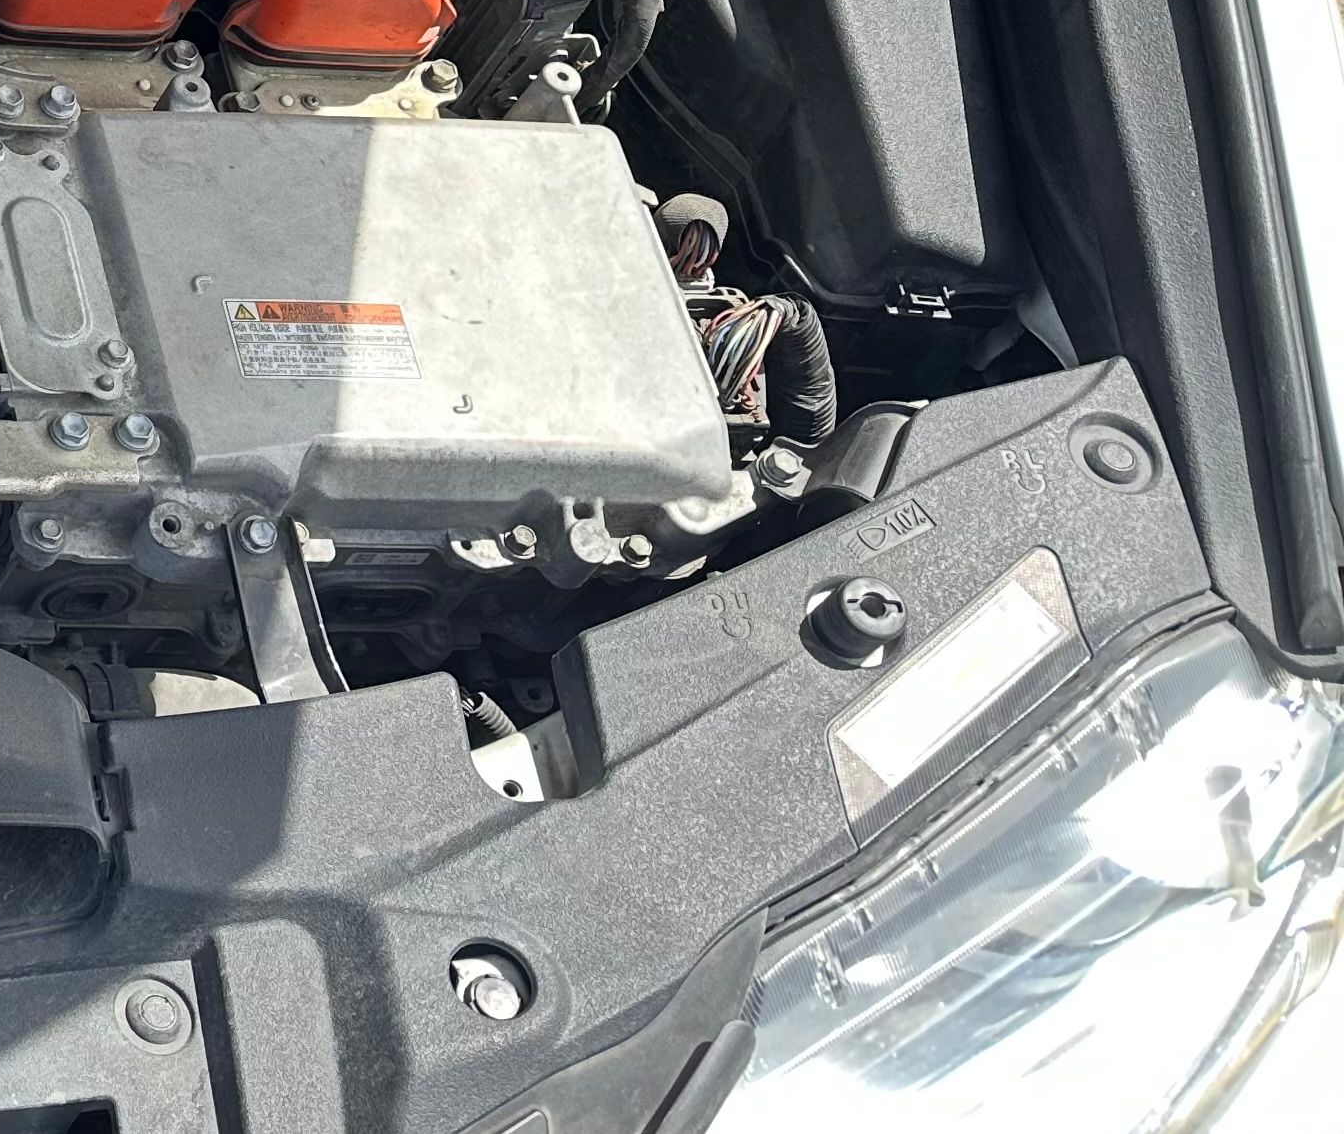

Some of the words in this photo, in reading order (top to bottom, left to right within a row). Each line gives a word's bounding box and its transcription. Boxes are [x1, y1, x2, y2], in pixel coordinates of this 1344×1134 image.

[280, 304, 323, 313] WARNING
[1000, 449, 1021, 470] R
[1025, 449, 1046, 470] L
[885, 498, 927, 536] 1.0%
